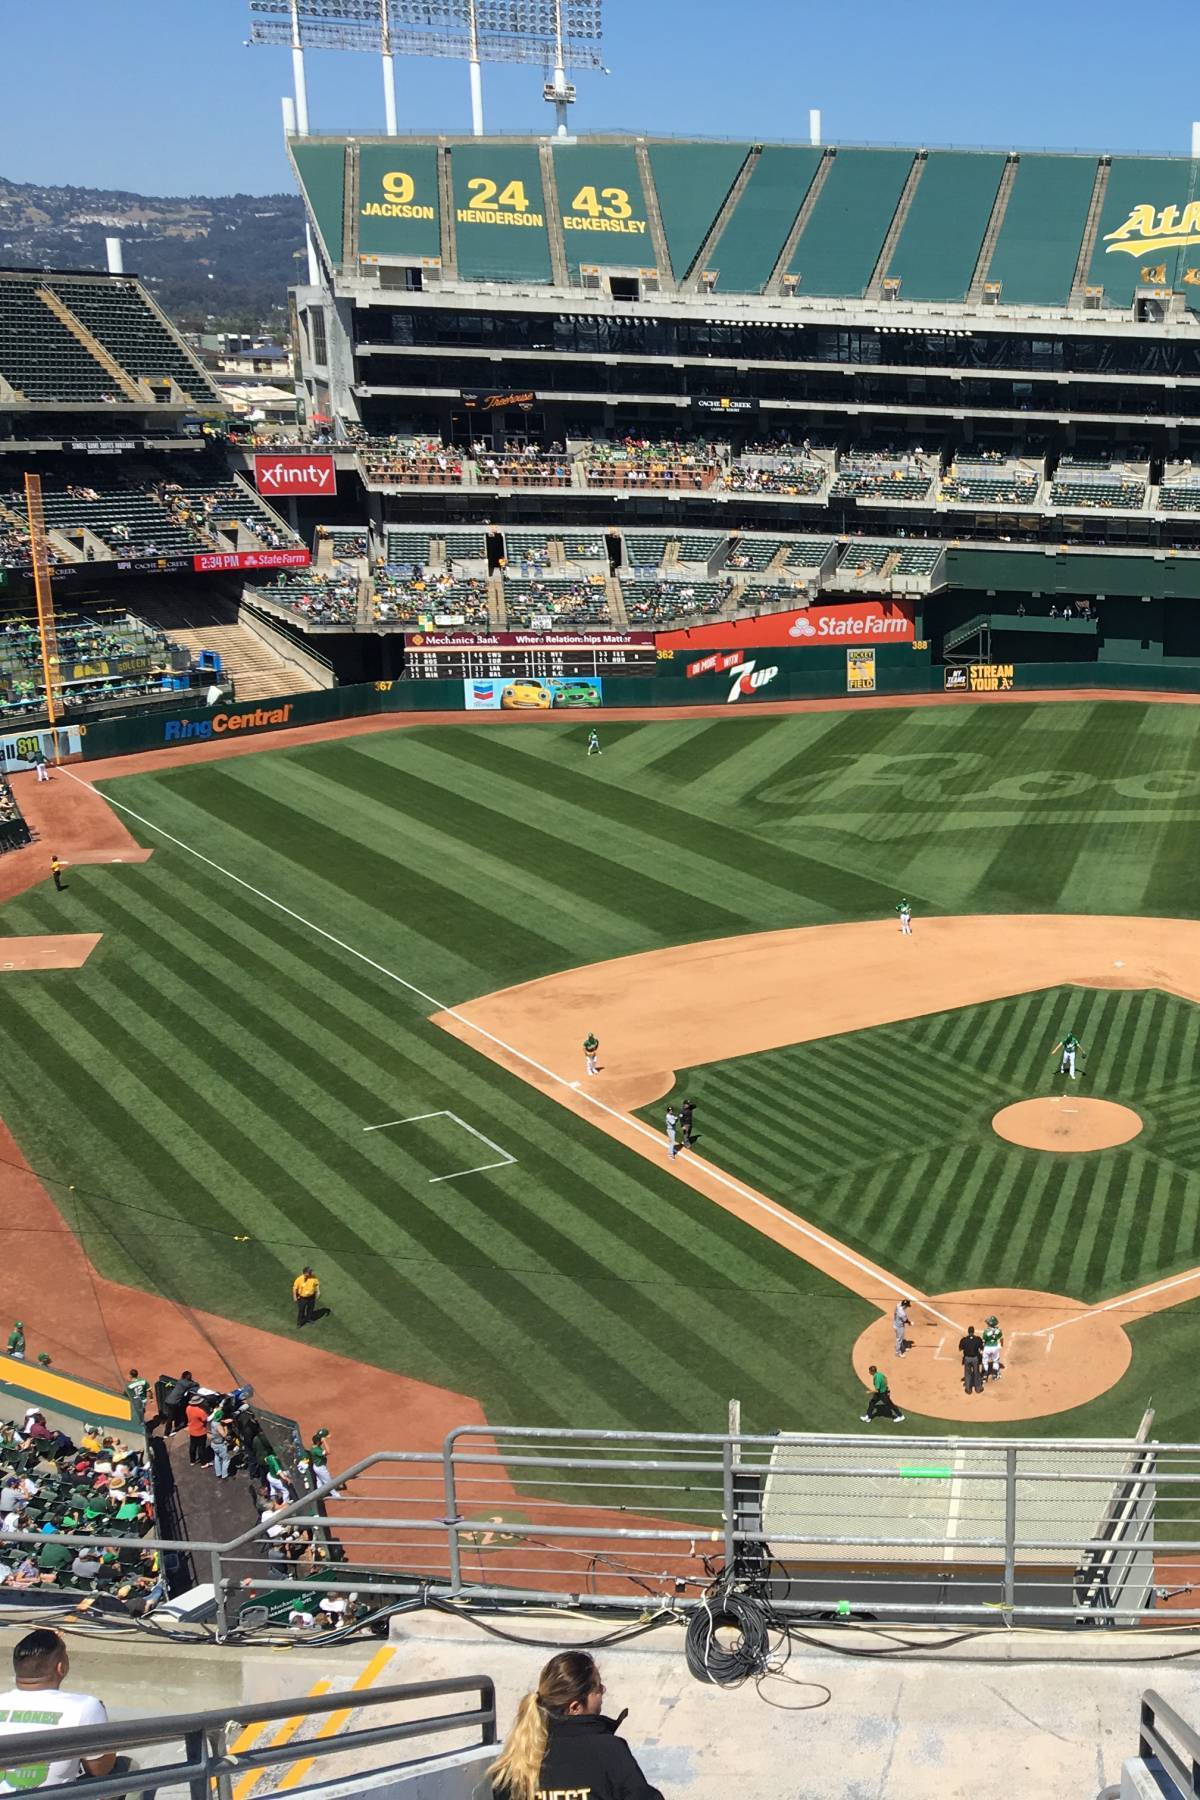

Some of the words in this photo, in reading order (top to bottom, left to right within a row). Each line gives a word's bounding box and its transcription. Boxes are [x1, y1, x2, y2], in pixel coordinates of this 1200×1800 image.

[382, 171, 415, 203] 9
[467, 178, 529, 212] 24
[571, 186, 633, 219] 43
[361, 203, 434, 219] JACKSON
[457, 209, 543, 227] HENDERSON
[563, 217, 646, 234] ECKERSLEY
[260, 463, 330, 487] xfinity
[201, 556, 221, 569] 2:34
[224, 555, 240, 567] PM
[425, 635, 474, 644] Mechanics
[477, 636, 498, 644] Bank
[545, 635, 601, 644] Relationships
[912, 641, 928, 650] 388
[656, 650, 674, 659] 362
[970, 665, 1013, 678] STREAM
[375, 681, 392, 690] 367
[728, 660, 756, 702] 7
[750, 666, 778, 688] UP
[850, 680, 873, 689] FIELD
[971, 679, 998, 691] YOUR
[165, 704, 290, 741] RingCentral
[18, 737, 38, 755] 811
[9, 1710, 64, 1725] MONEY
